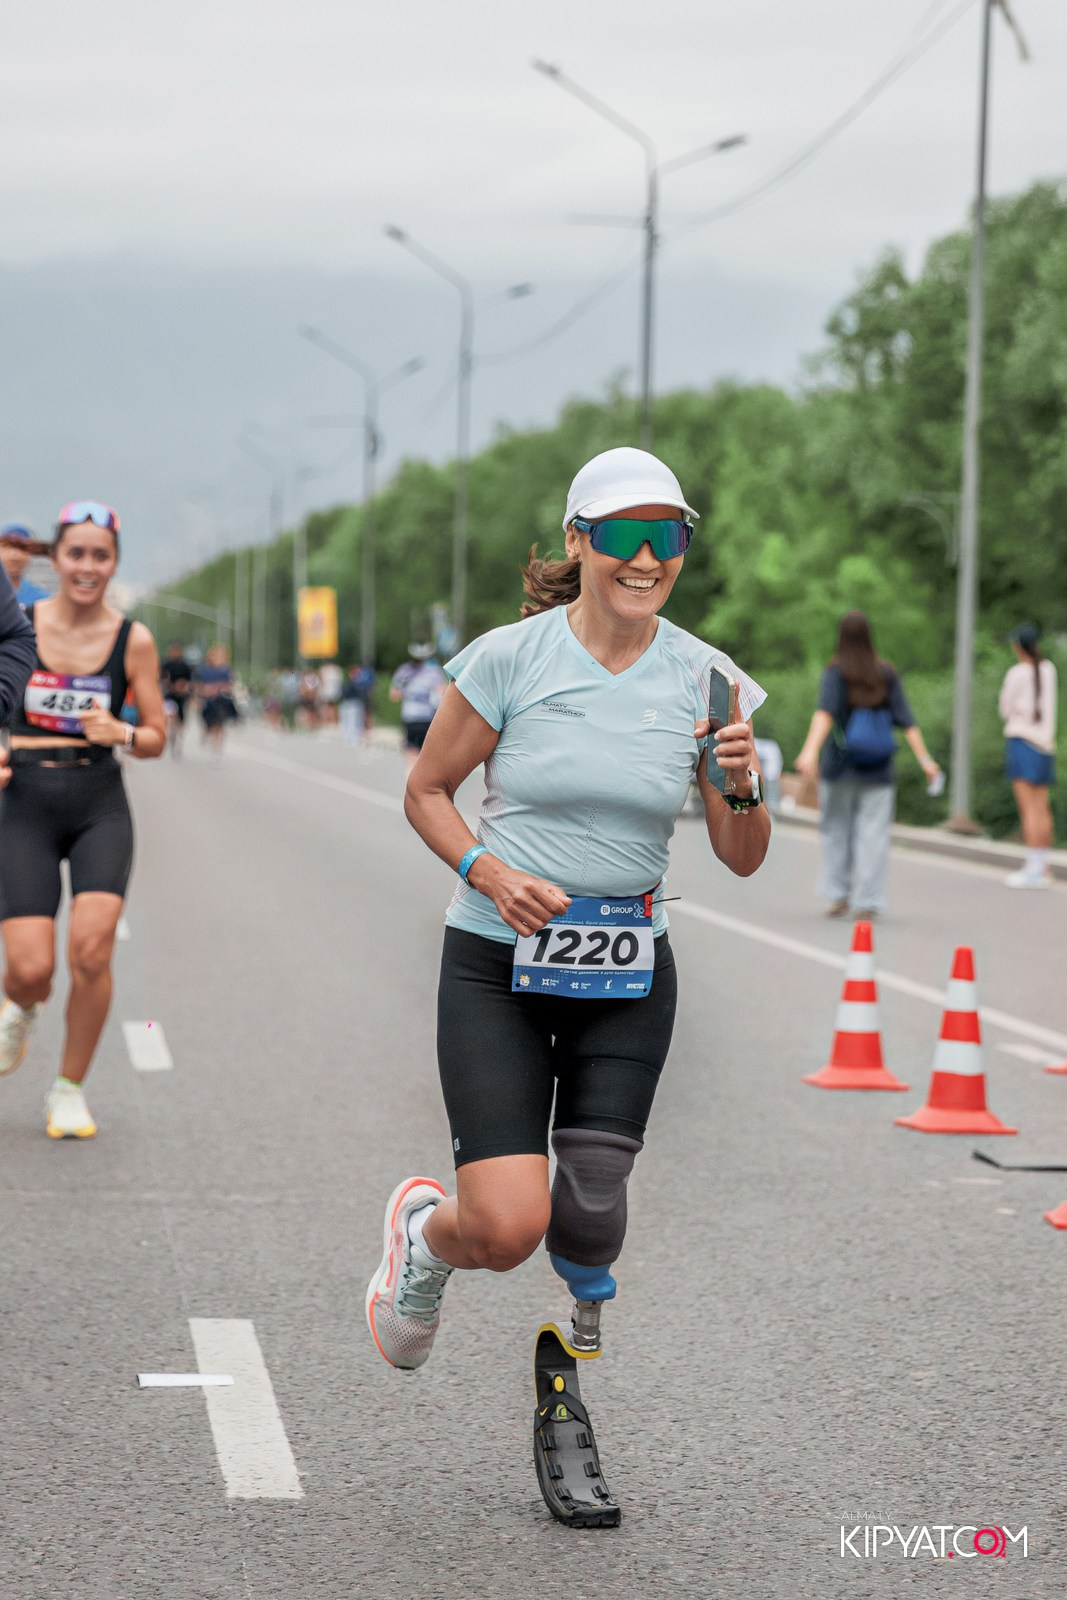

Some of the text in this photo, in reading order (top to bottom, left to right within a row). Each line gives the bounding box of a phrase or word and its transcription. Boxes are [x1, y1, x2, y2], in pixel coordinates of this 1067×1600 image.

[549, 708, 586, 717] MARATHON
[611, 906, 633, 914] GROUP
[532, 928, 639, 966] 1220
